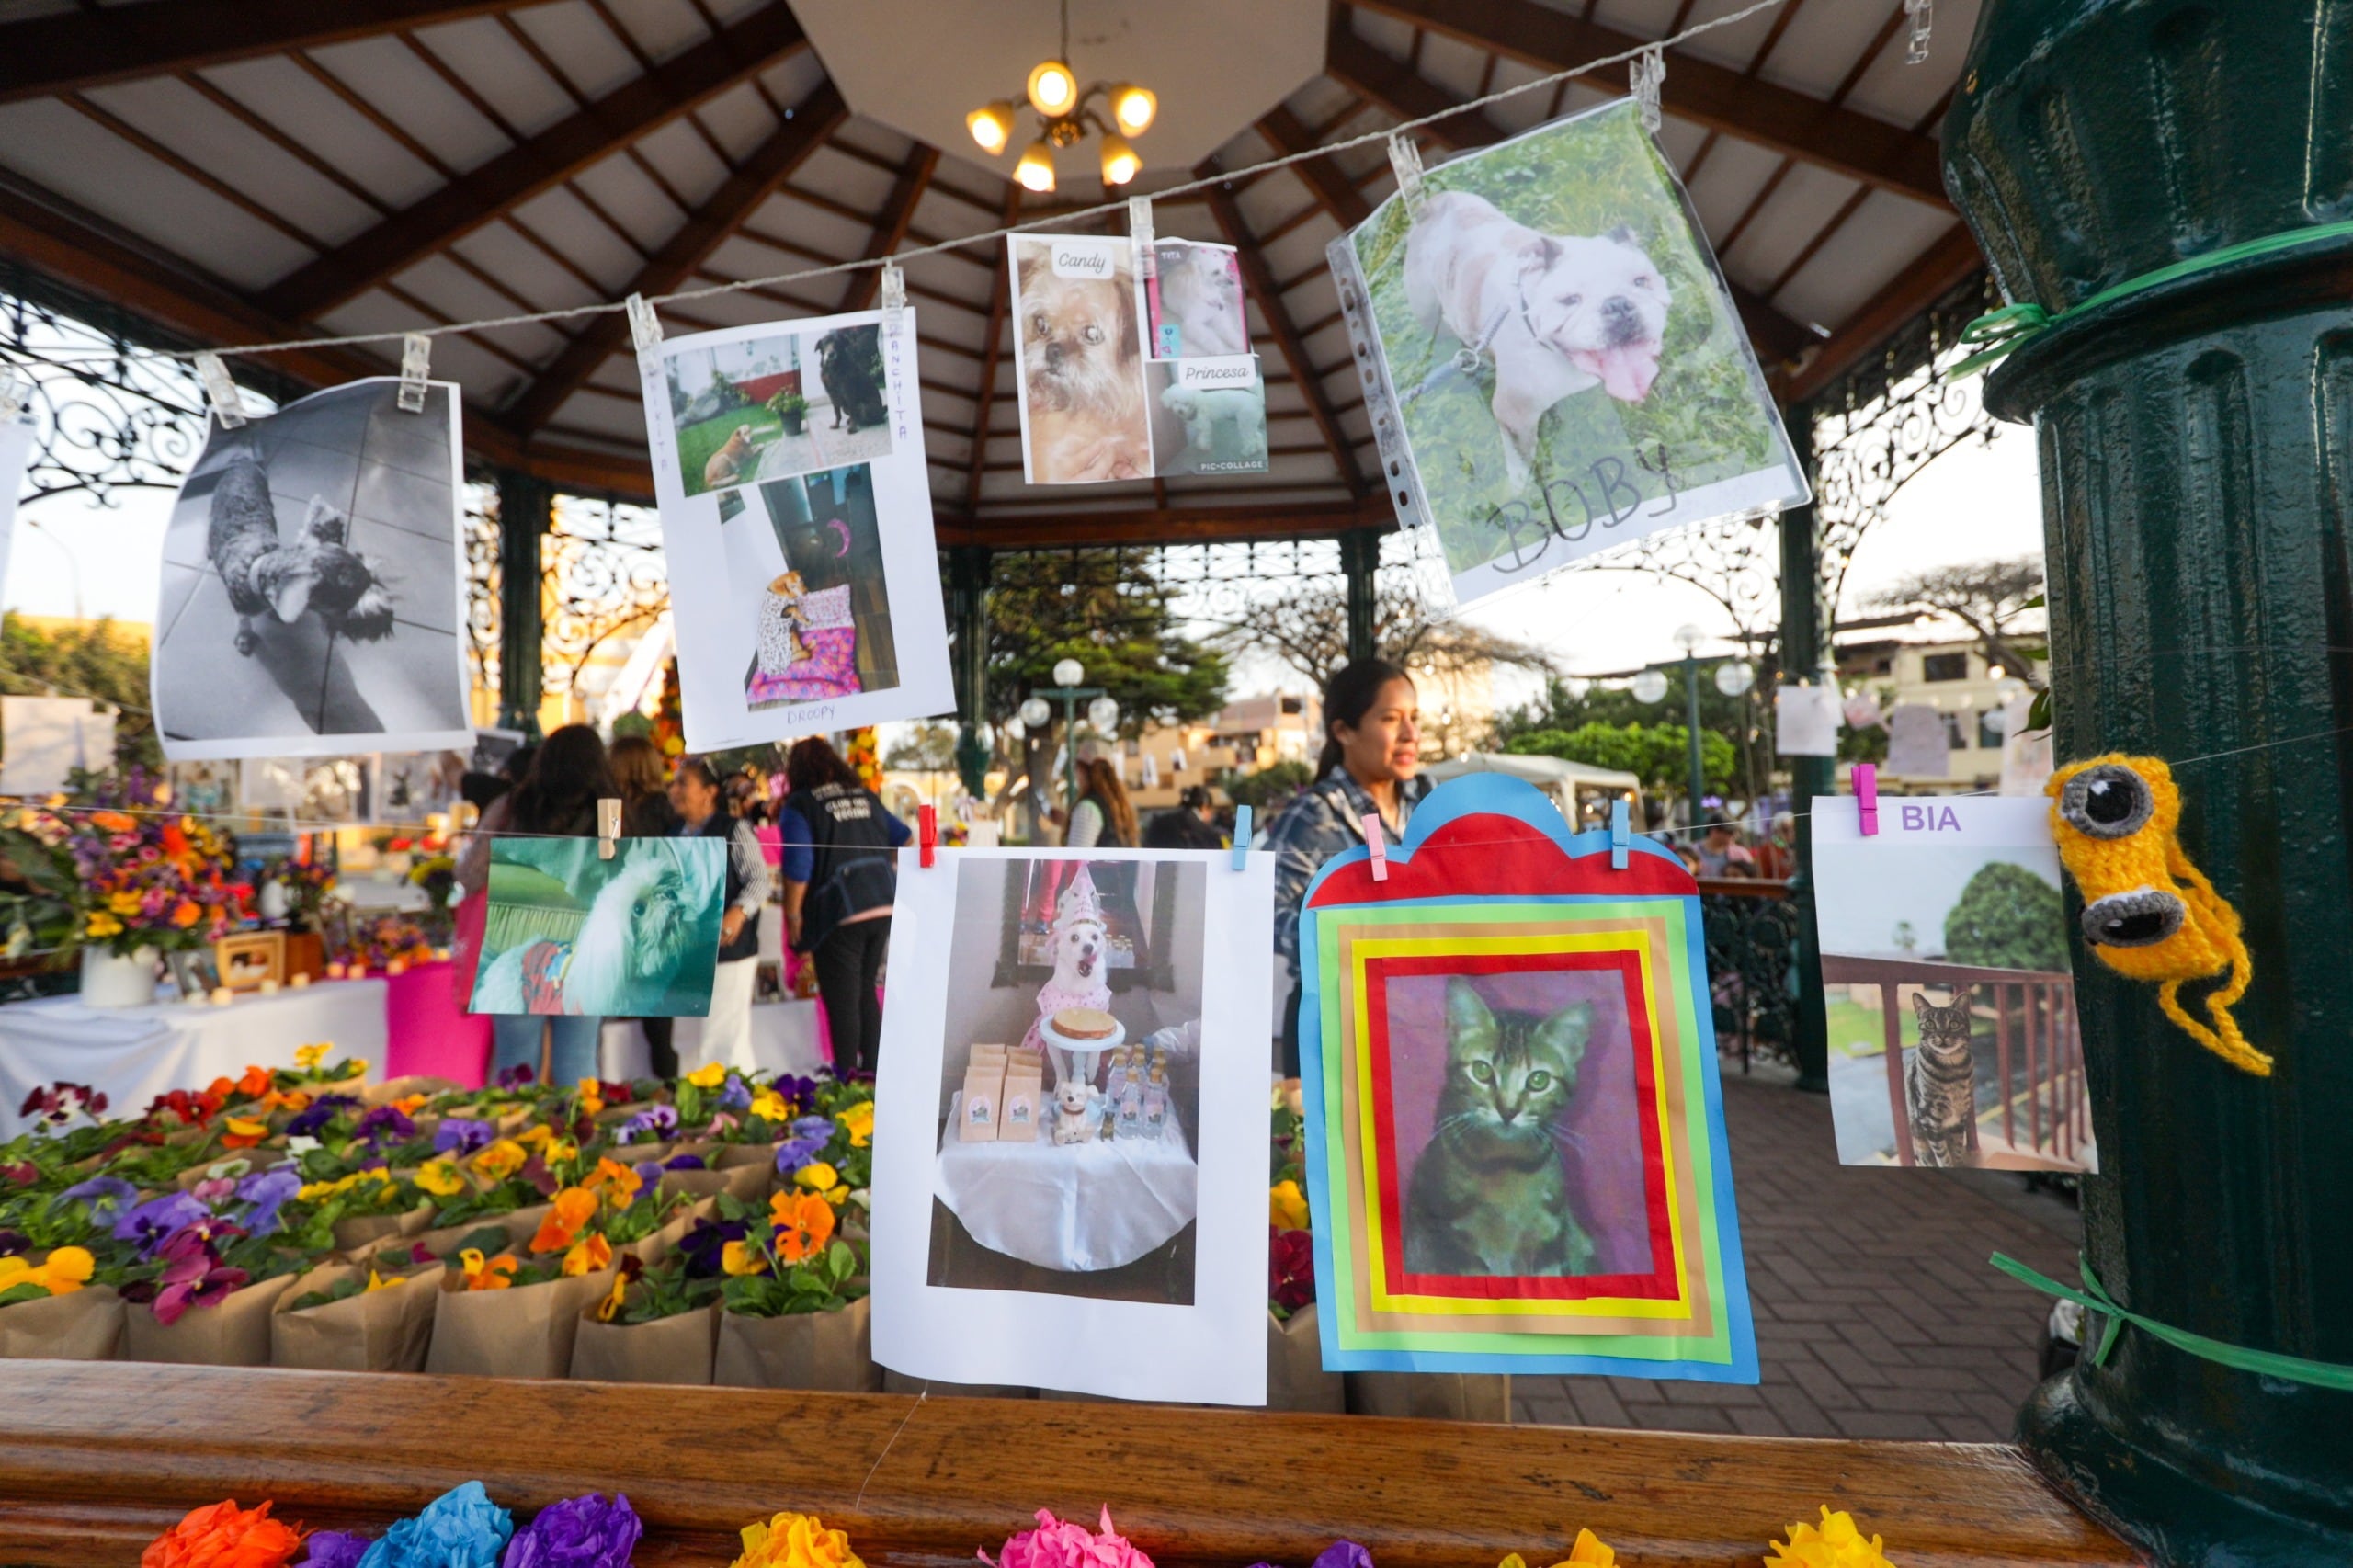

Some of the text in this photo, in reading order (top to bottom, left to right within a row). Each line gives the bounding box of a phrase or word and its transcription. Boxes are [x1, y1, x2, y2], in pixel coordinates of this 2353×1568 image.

[1058, 252, 1107, 274] Candy
[1185, 365, 1249, 380] Princesa
[1485, 442, 1677, 574] BOBY
[788, 704, 835, 724] DROOPY
[1902, 806, 1962, 831] BIA
